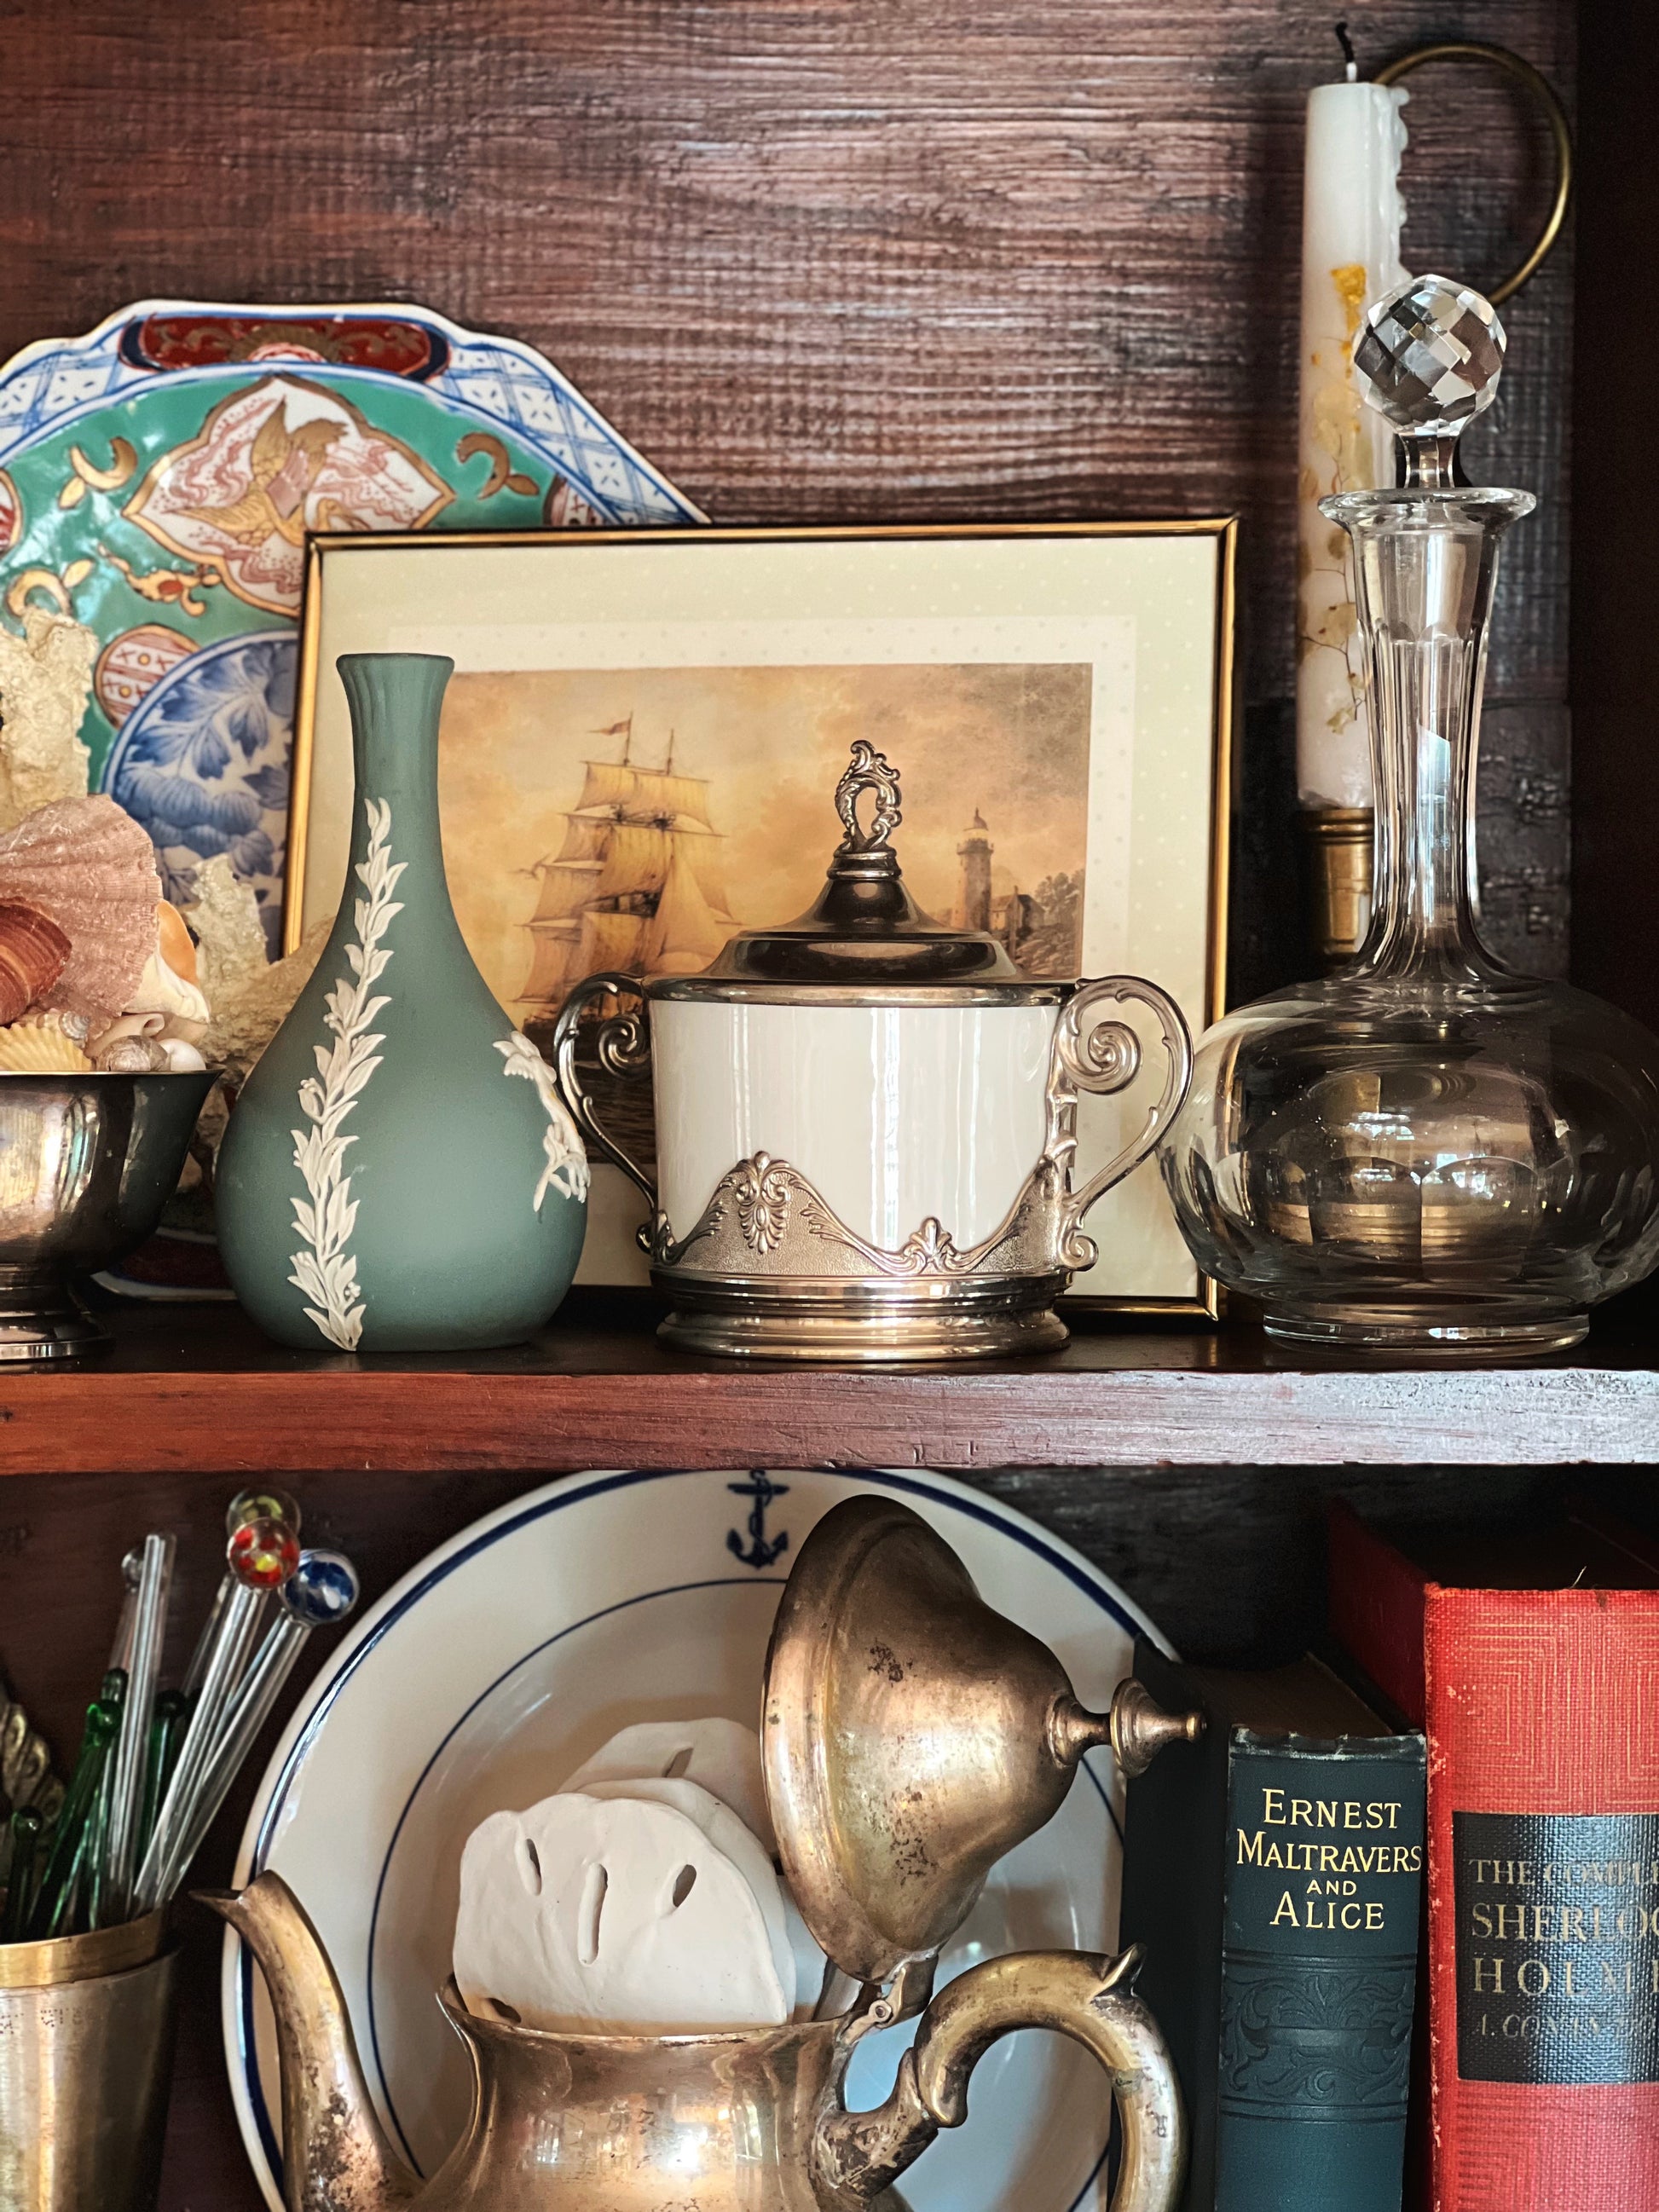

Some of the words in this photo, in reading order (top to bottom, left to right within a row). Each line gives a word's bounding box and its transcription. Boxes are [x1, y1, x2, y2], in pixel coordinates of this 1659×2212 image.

[1262, 1788, 1402, 1828] ERNEST
[1236, 1828, 1422, 1873] MALTRAVERS
[1306, 1879, 1357, 1896] AND
[1468, 1858, 1535, 1886] THE
[1269, 1890, 1384, 1930] ALICE
